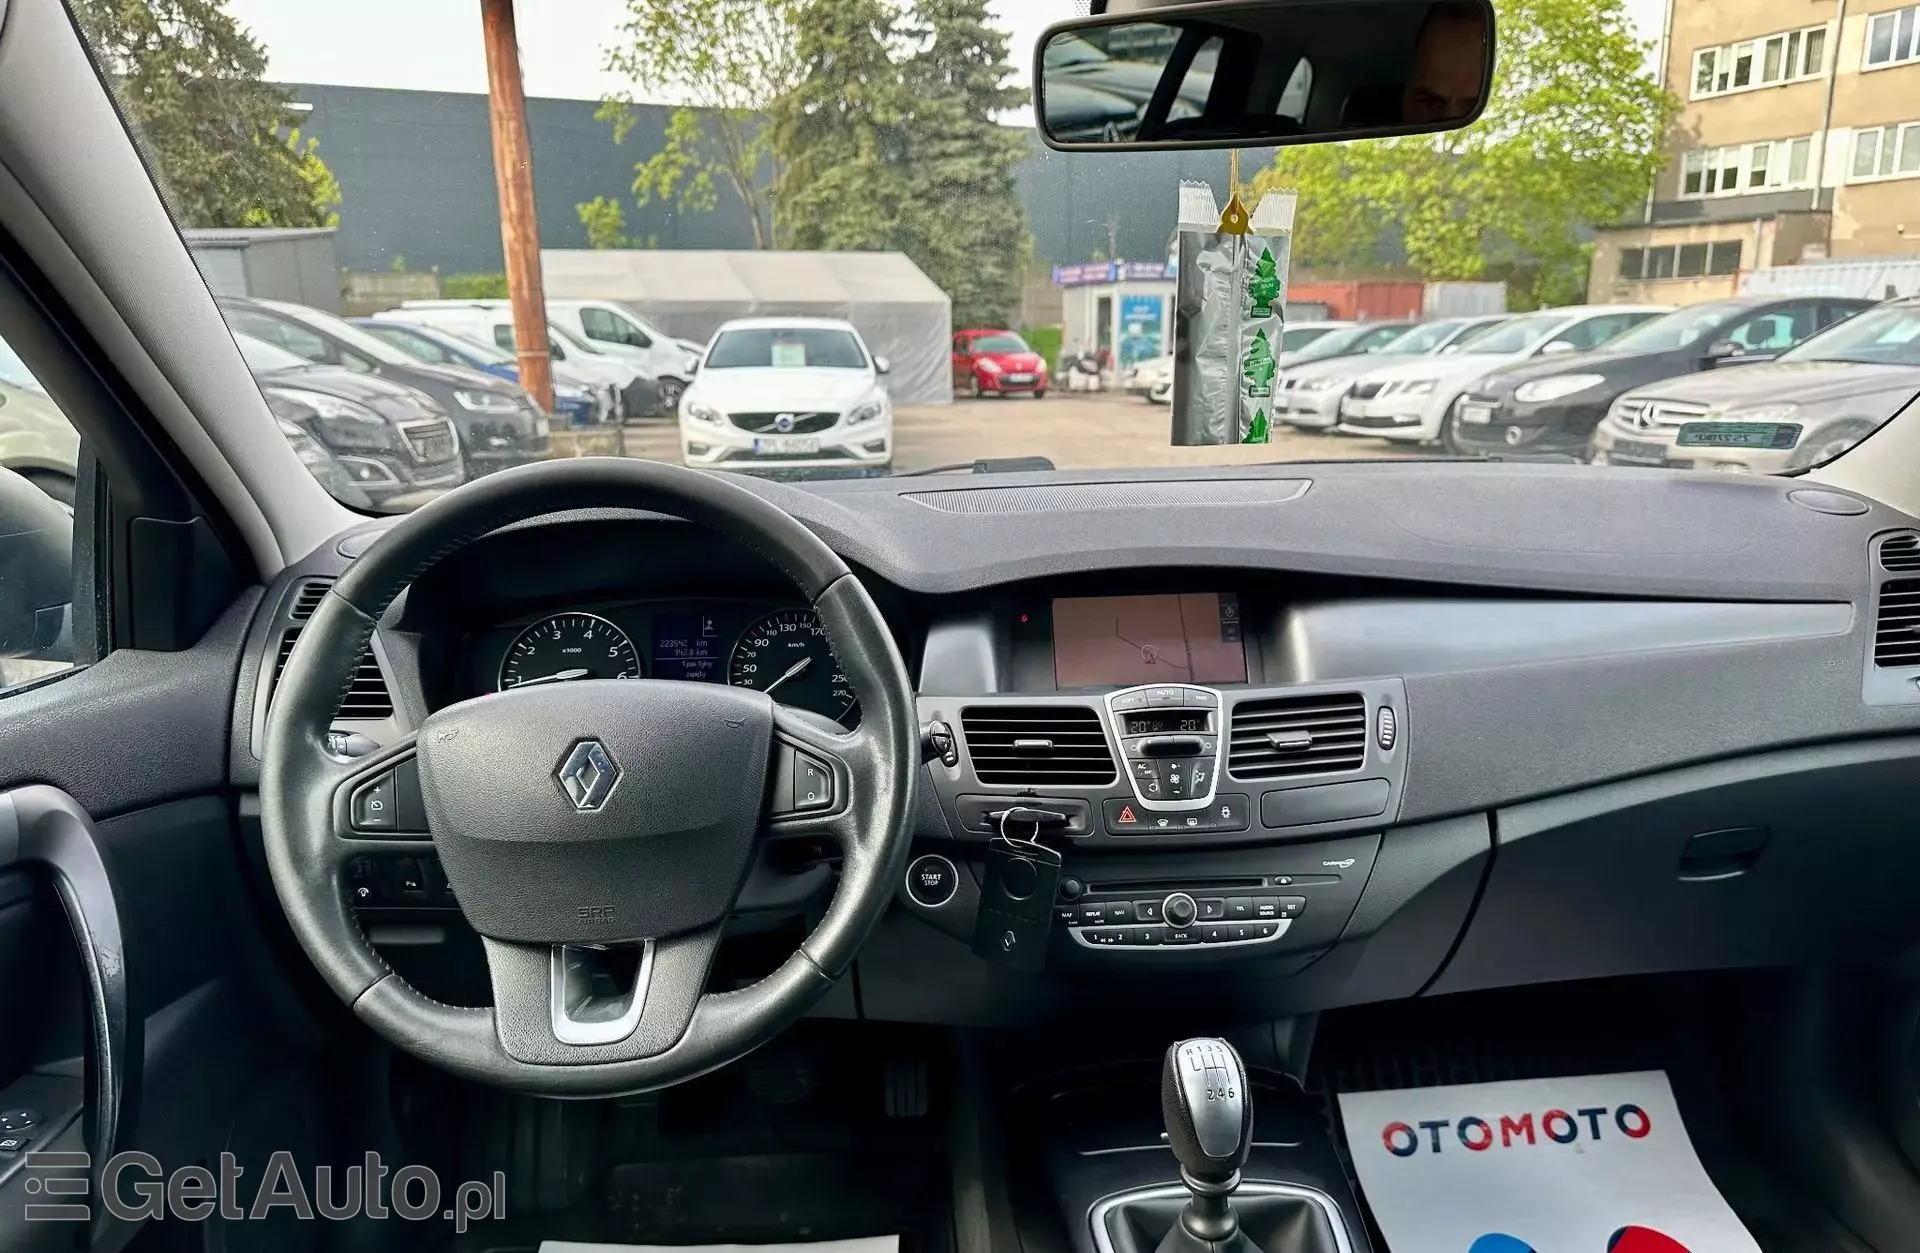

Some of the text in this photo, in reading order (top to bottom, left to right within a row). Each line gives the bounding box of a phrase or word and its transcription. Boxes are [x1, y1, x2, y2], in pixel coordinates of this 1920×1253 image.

[779, 623, 797, 632] 130
[552, 630, 562, 640] 3
[583, 630, 594, 640] 4
[696, 639, 708, 647] km
[754, 638, 769, 647] 90
[526, 646, 536, 655] 2
[608, 646, 619, 657] 5
[696, 648, 708, 656] km
[742, 664, 757, 673] 50
[807, 768, 814, 777] R
[1211, 929, 1218, 938] 4
[1239, 928, 1244, 936] 5
[1263, 926, 1269, 934] 6
[1093, 933, 1098, 941] 1
[1118, 933, 1123, 941] 2
[1145, 932, 1150, 940] 3
[1206, 1087, 1235, 1100] 2 4 6
[1382, 1103, 1652, 1157] OTOMOTO
